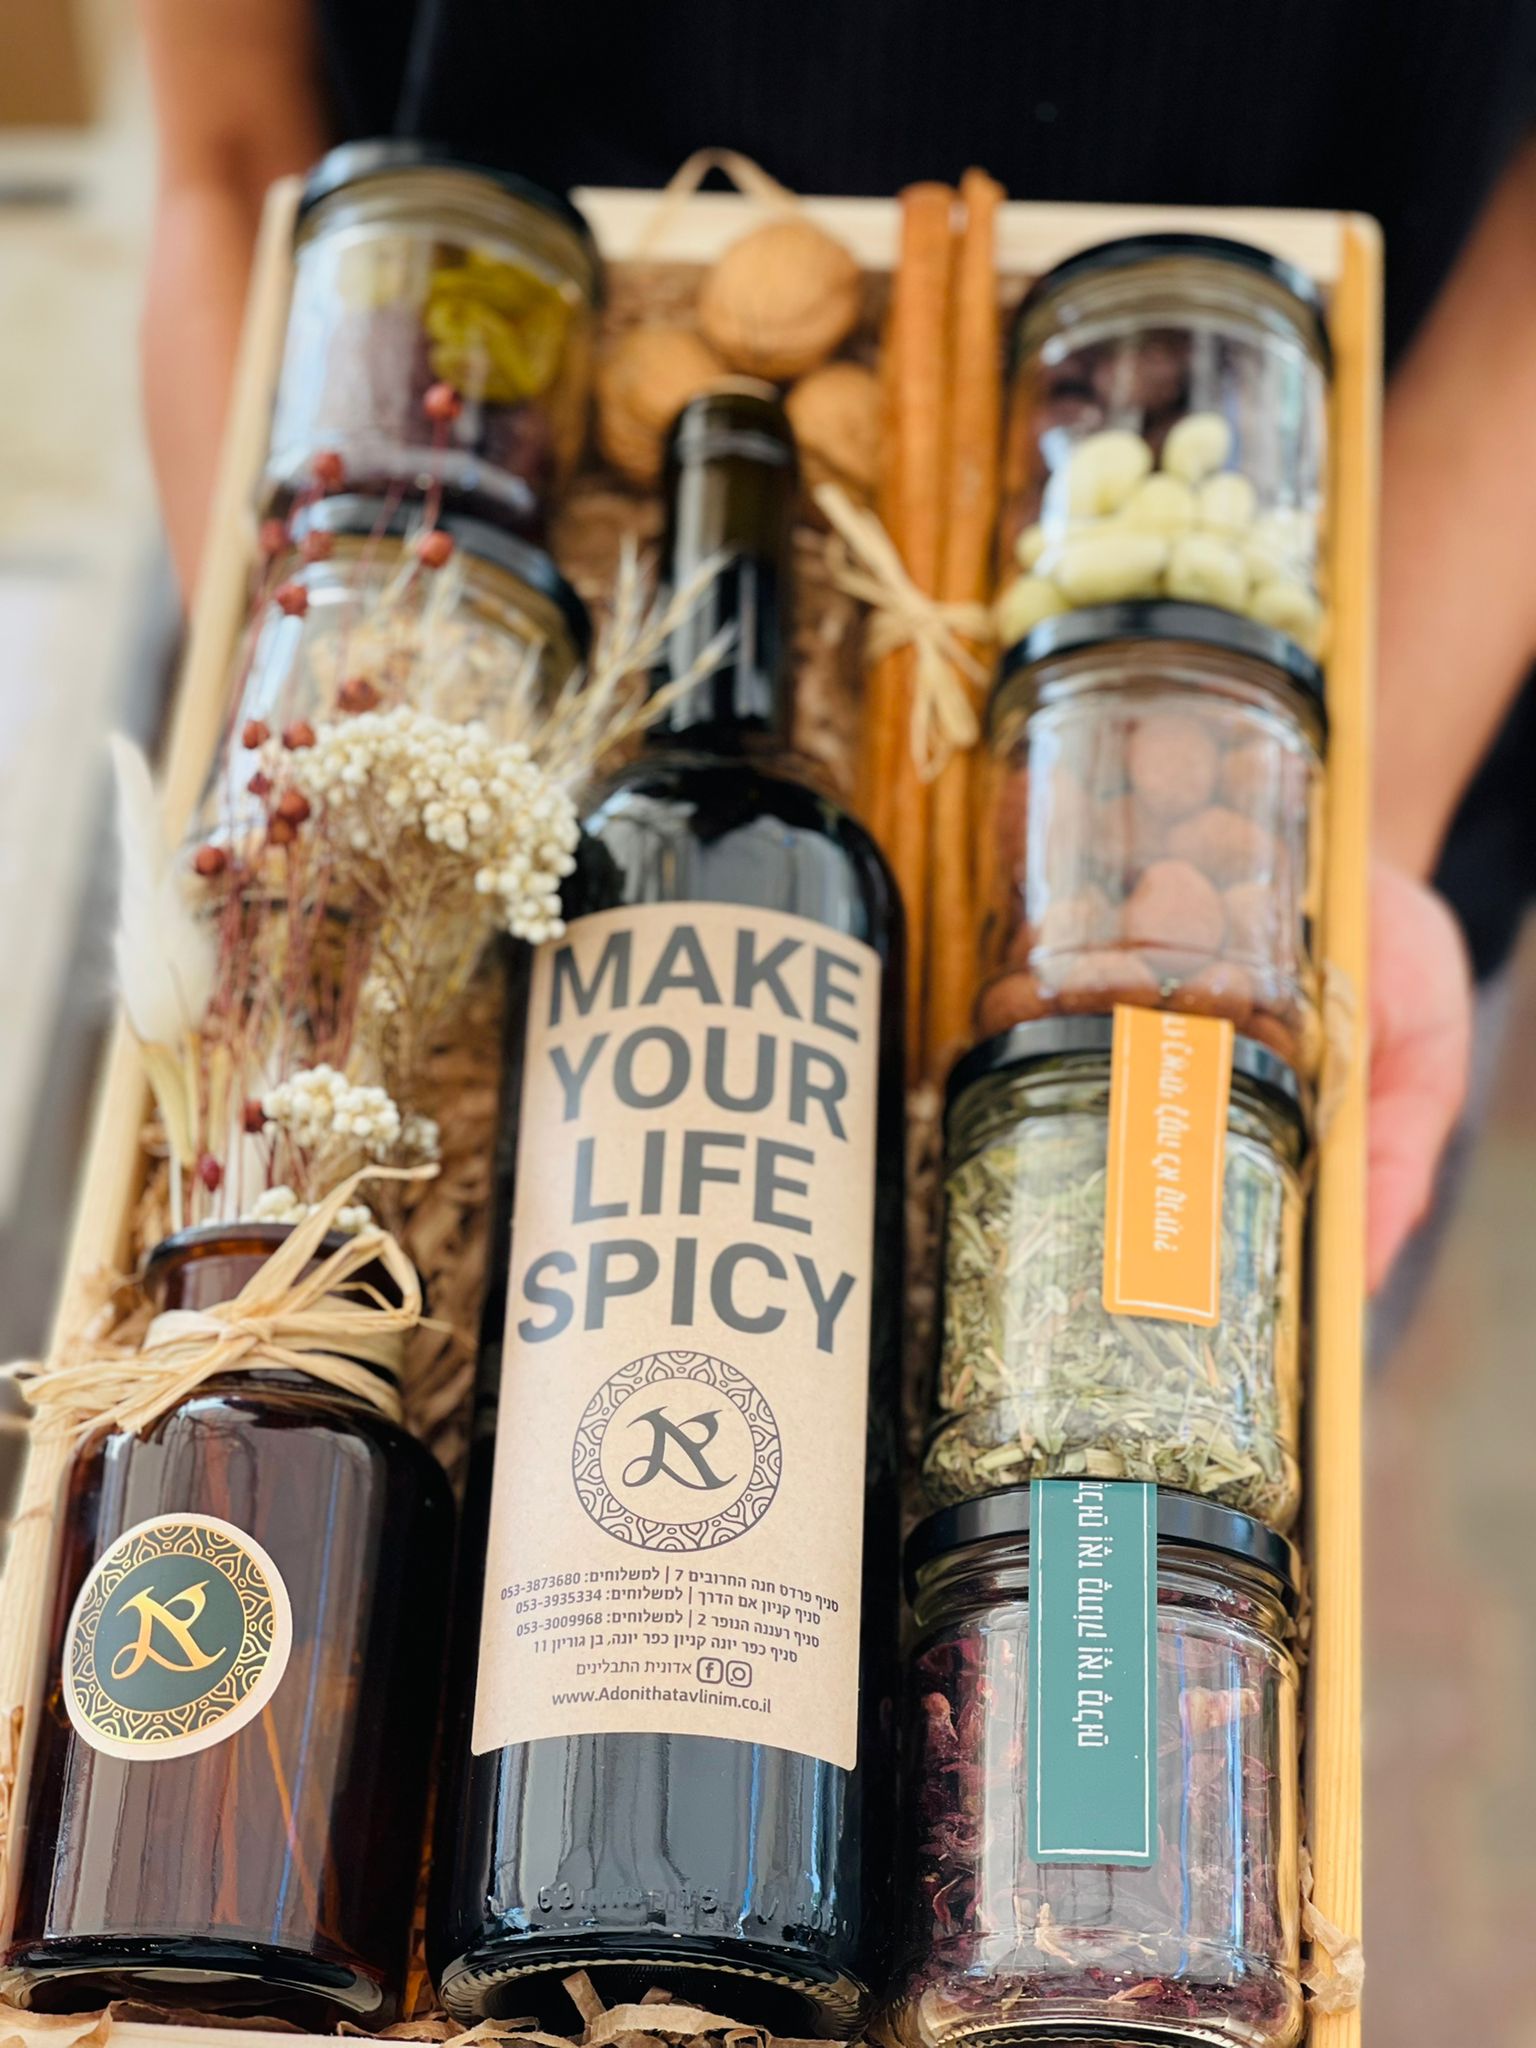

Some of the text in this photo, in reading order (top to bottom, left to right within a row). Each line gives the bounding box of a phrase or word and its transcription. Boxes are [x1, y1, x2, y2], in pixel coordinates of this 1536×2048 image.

[547, 925, 861, 1043] MAKE
[547, 1025, 849, 1142] YOUR
[572, 1129, 815, 1235] LIFE
[517, 1237, 857, 1355] SPICY
[675, 1569, 684, 1582] 7
[689, 1569, 746, 1588] החרובים
[500, 1572, 581, 1600] 053-3873680
[751, 1578, 775, 1593] חנה
[780, 1584, 812, 1602] פרדס
[515, 1589, 602, 1614] 053-3935334
[698, 1591, 734, 1606] הדרך
[738, 1595, 757, 1610] אם
[815, 1594, 839, 1612] סניף
[761, 1600, 791, 1619] קניון
[795, 1607, 821, 1625] סניף
[516, 1612, 603, 1637] 053-3009968
[697, 1613, 707, 1626] 2
[711, 1615, 750, 1631] הנופר
[643, 1632, 669, 1645] כפר
[754, 1621, 790, 1640] רעננה
[794, 1630, 820, 1648] סניף
[552, 1635, 586, 1653] גוריון
[590, 1633, 604, 1649] בן
[607, 1633, 638, 1647] יונה,
[674, 1633, 706, 1650] קניון
[711, 1635, 737, 1649] יונה
[741, 1640, 766, 1656] כפר
[770, 1647, 798, 1663] סניף
[576, 1658, 692, 1676] אדונית התבלינים
[551, 1687, 772, 1713] www.Adonithatavlinim.co.il
